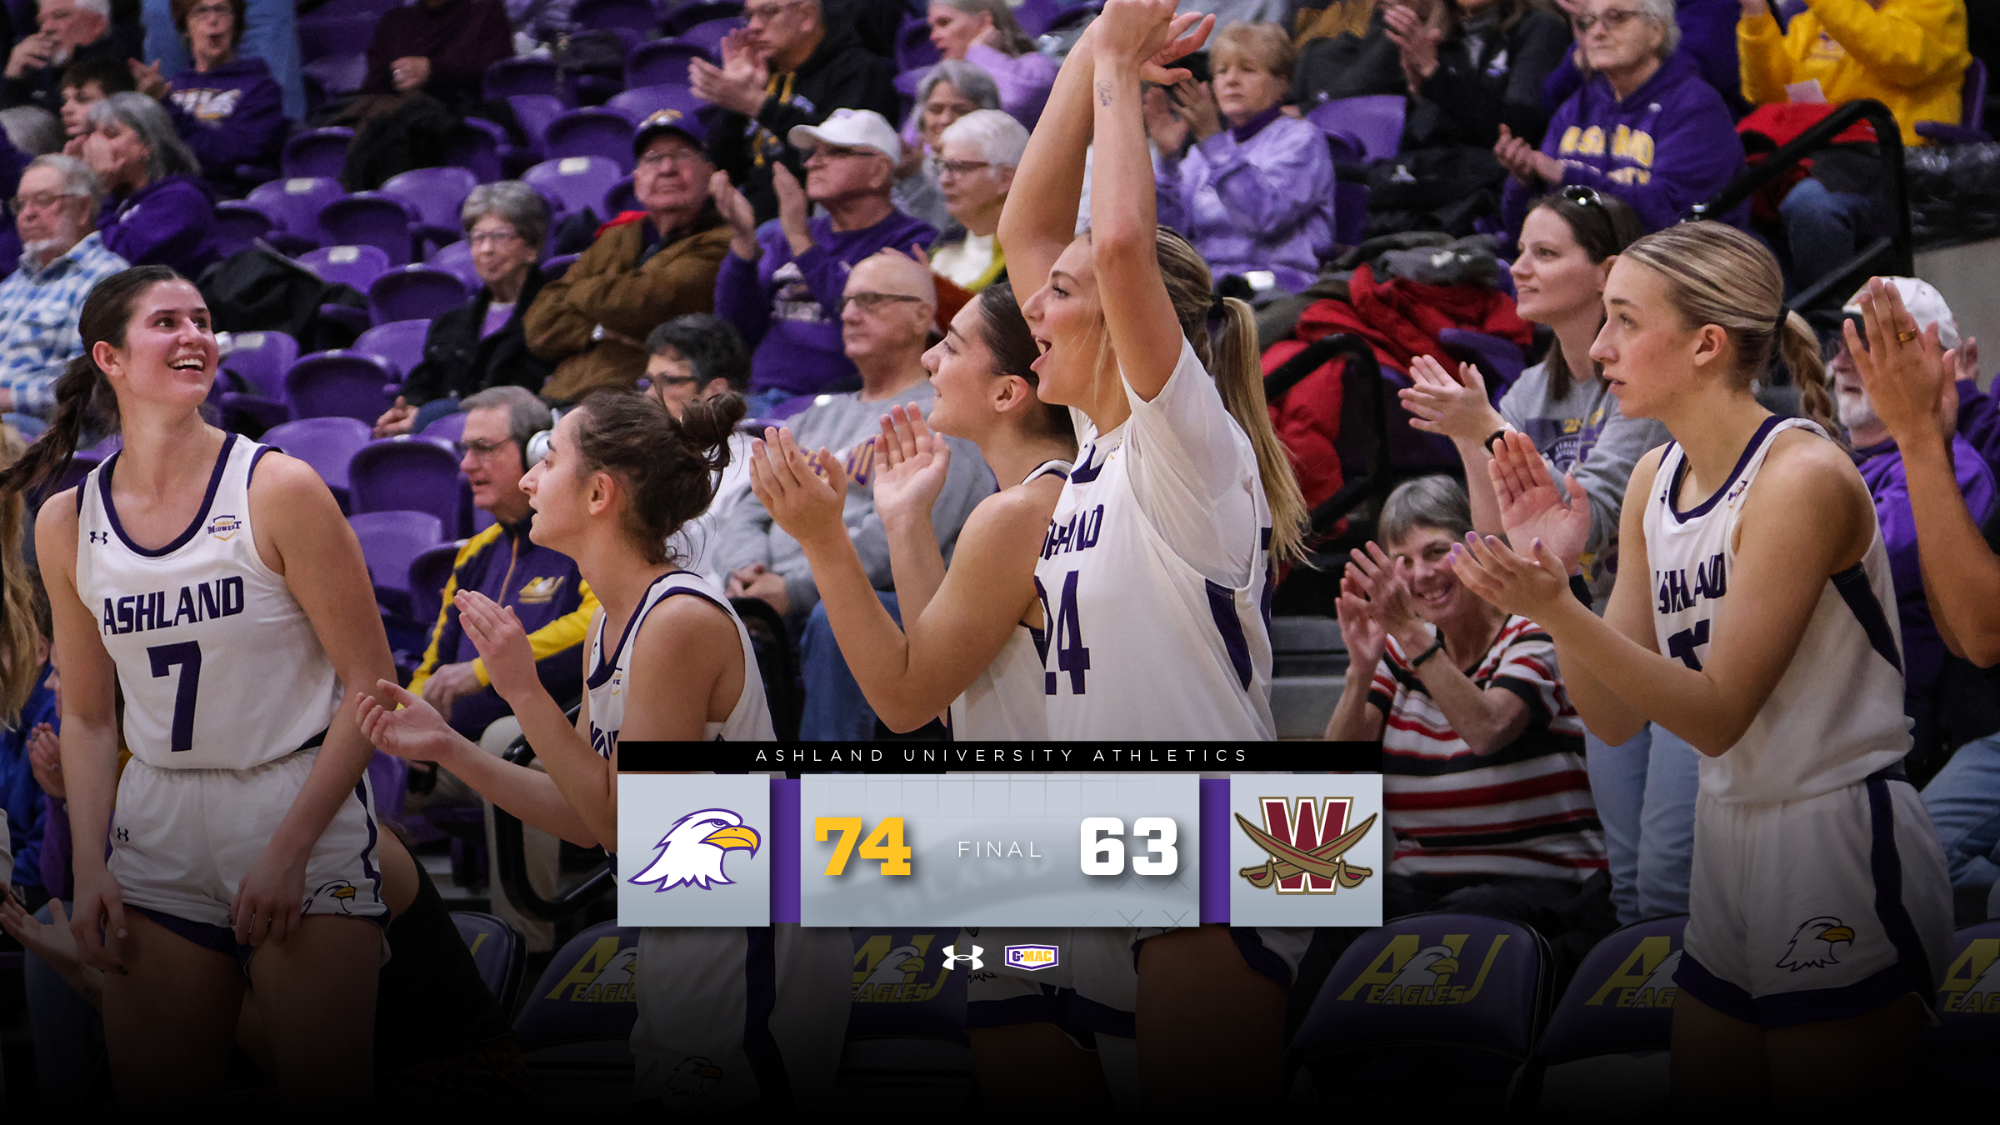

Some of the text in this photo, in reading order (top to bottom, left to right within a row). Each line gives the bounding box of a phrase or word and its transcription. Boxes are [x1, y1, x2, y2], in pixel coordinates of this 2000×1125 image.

[103, 575, 245, 636] ASHLAND
[146, 640, 202, 752] 7
[1365, 984, 1467, 1006] EAGLES
[1616, 987, 1677, 1008] EAG
